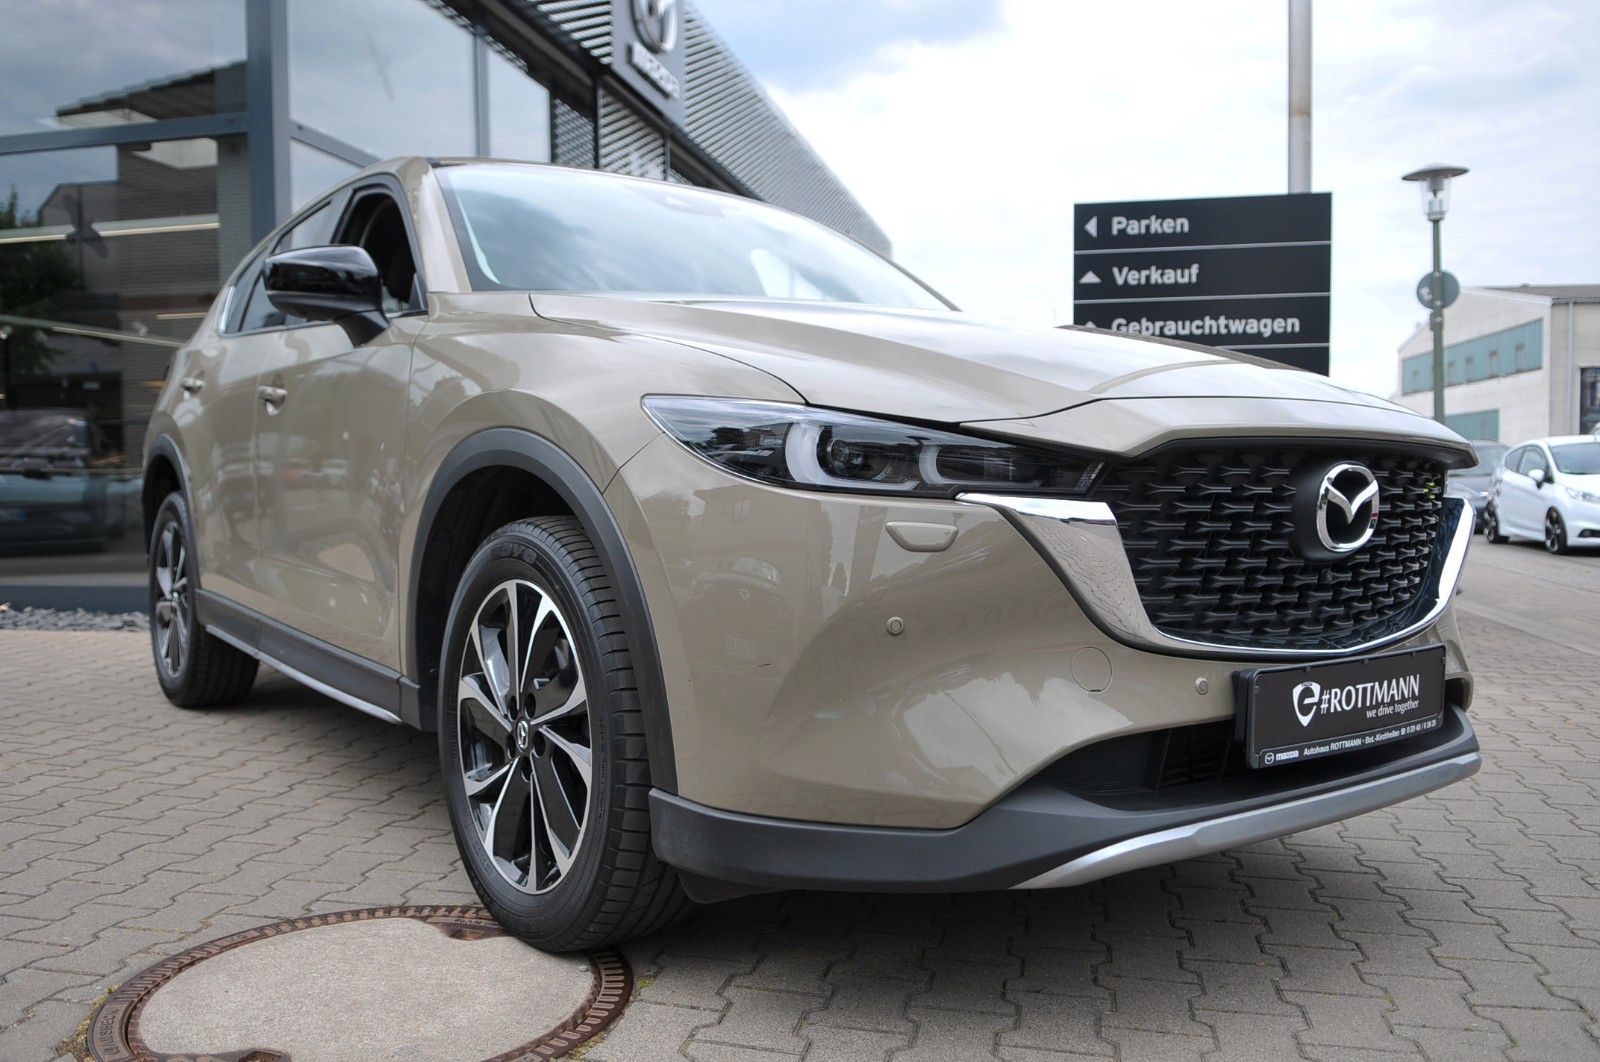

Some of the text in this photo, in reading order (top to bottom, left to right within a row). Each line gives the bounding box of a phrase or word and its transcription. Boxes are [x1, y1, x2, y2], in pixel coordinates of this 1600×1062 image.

[1111, 214, 1189, 236] Parken
[1111, 263, 1200, 286] Verkauf
[1111, 315, 1300, 338] Gebrauchtwagen
[1320, 674, 1420, 715] #ROTTMANN
[1366, 699, 1420, 718] we drive together
[1303, 745, 1330, 757] Autohaus
[1330, 738, 1362, 751] ROTTMANN
